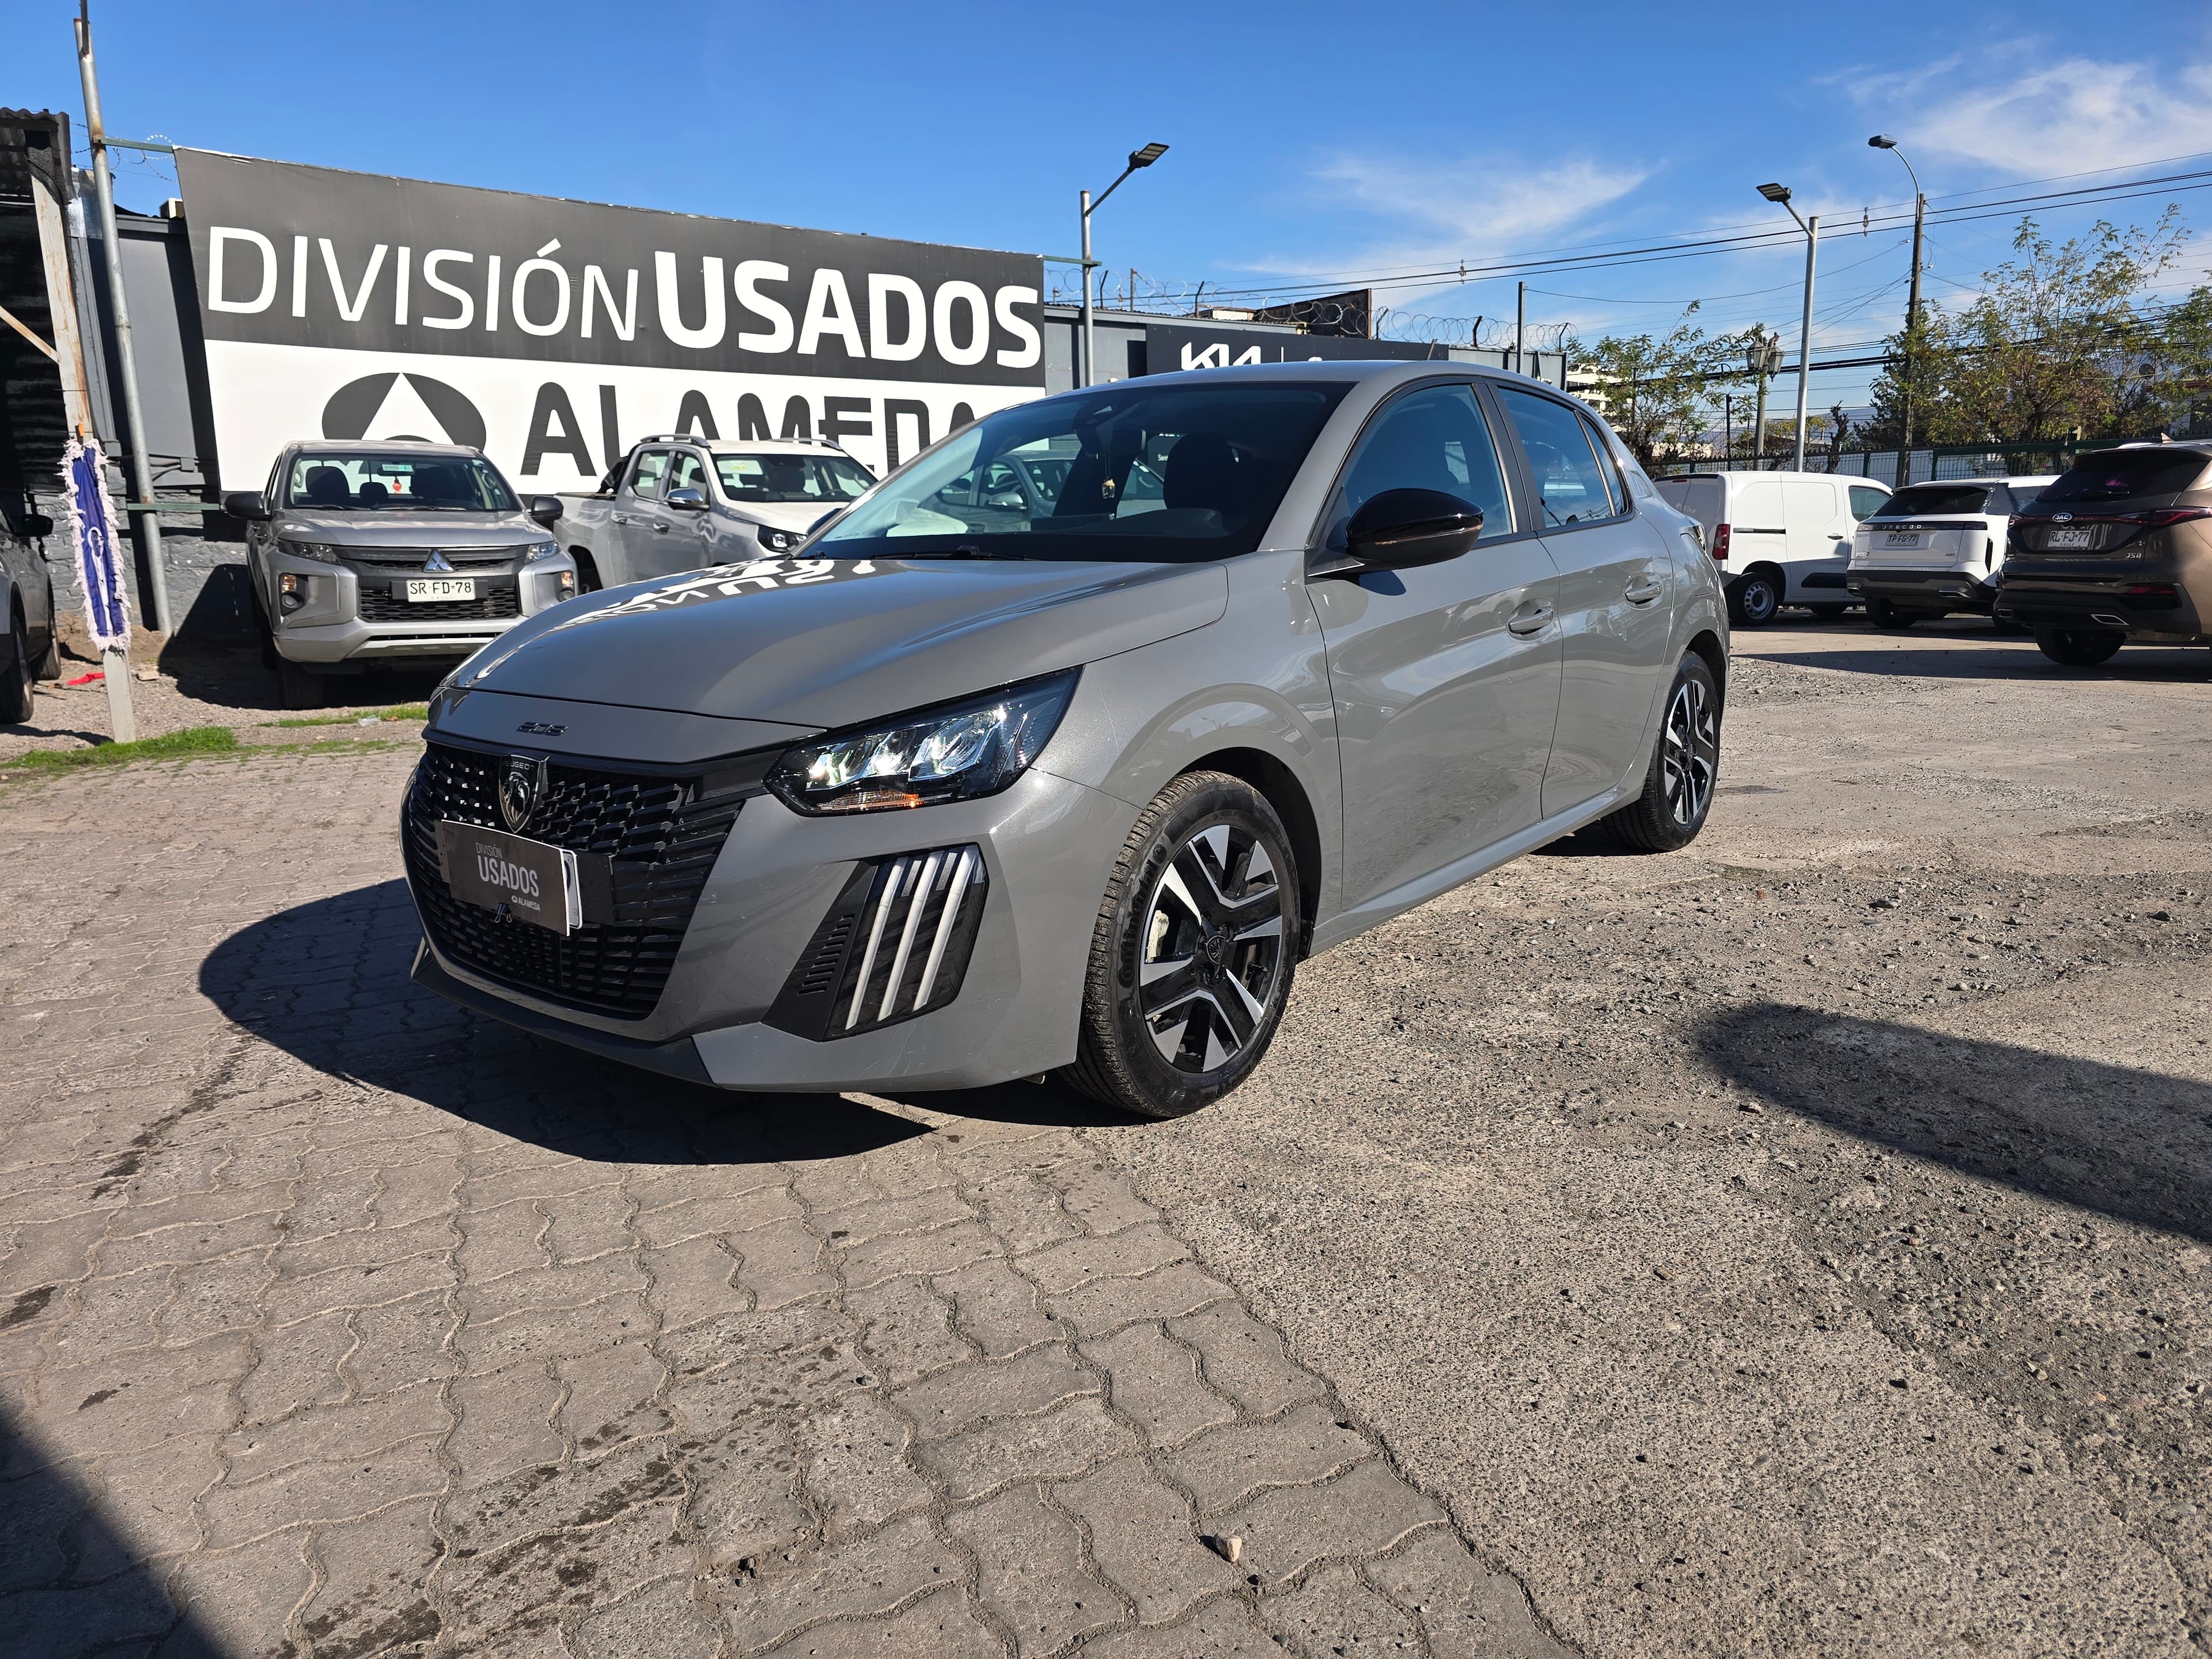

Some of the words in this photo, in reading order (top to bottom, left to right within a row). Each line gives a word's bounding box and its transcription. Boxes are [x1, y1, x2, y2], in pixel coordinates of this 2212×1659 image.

[209, 226, 638, 340] DIVISIÓN
[654, 251, 1041, 369] USADOS
[477, 855, 539, 897] USADOS
